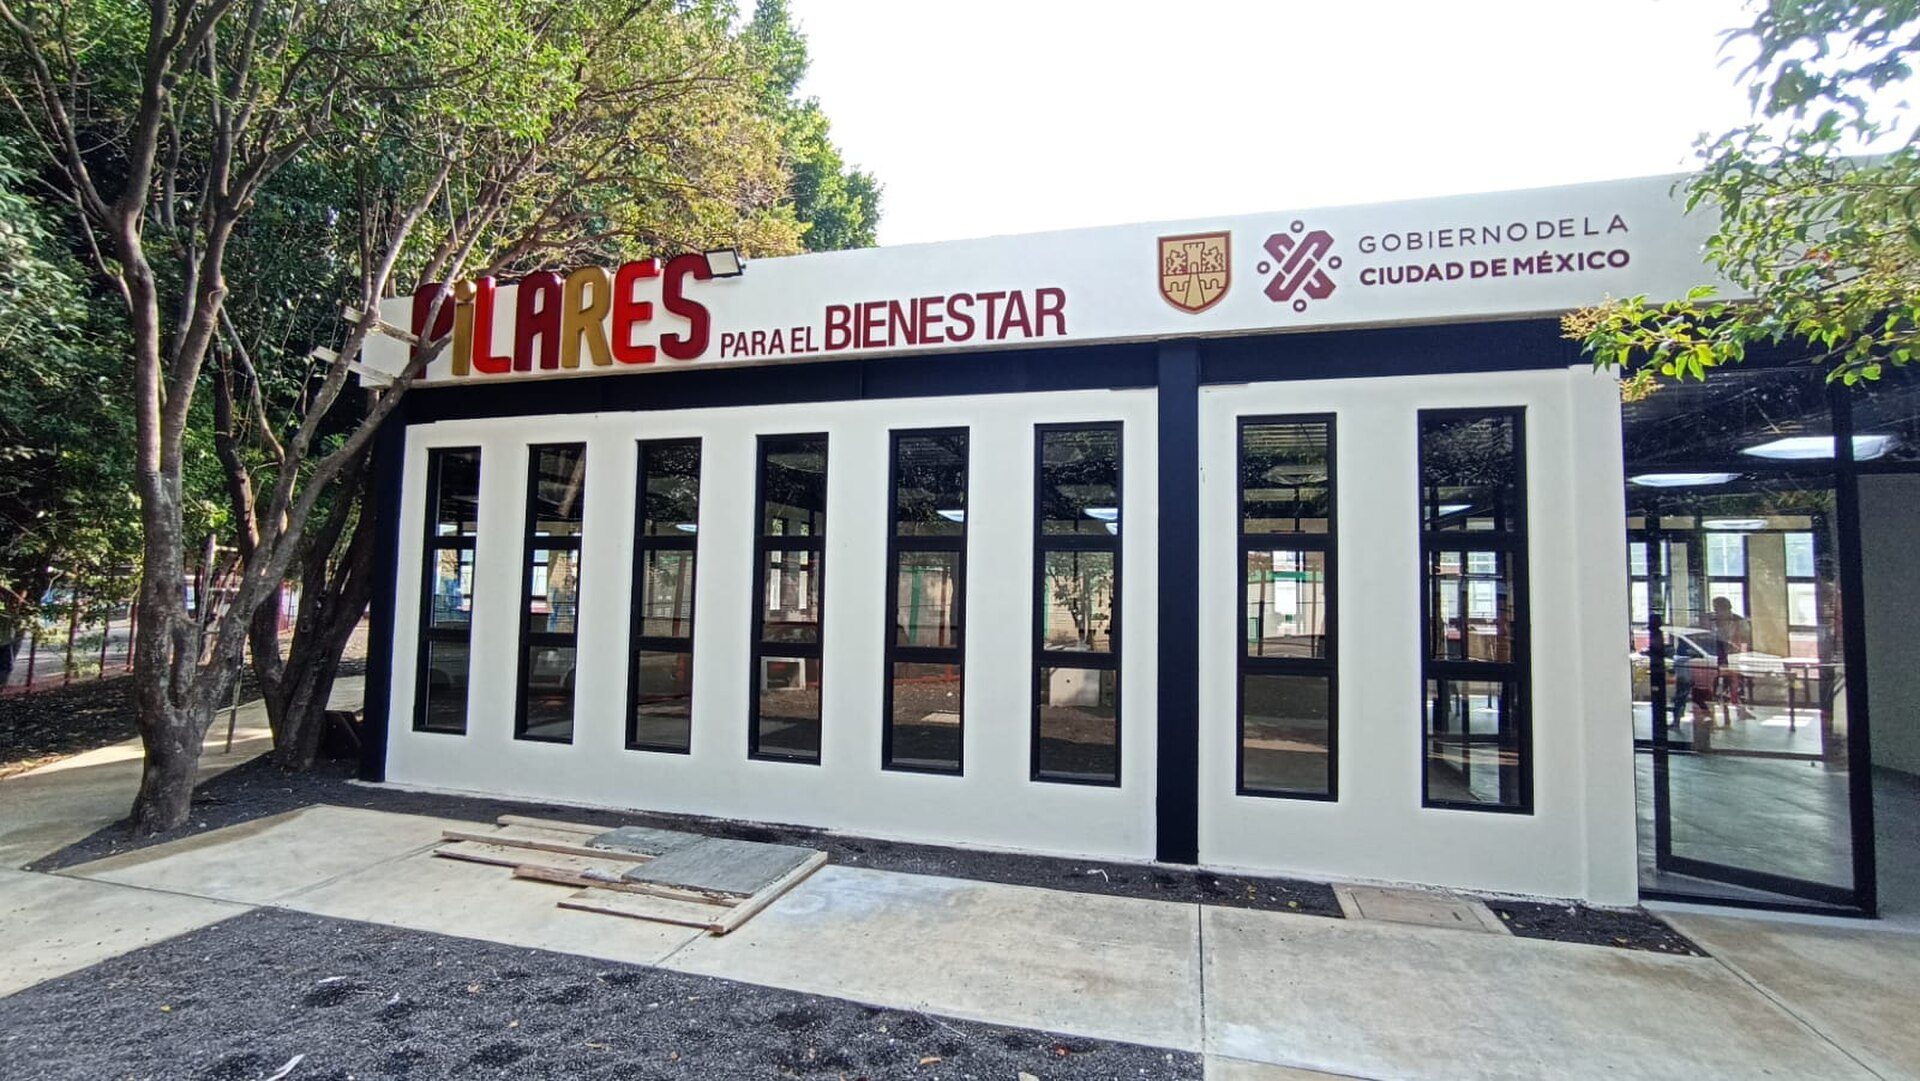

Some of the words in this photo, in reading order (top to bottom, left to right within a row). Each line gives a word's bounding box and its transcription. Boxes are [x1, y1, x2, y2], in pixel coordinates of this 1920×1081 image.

[1358, 222, 1528, 254] GOBIERNO
[1536, 218, 1575, 240] DE
[1584, 214, 1628, 236] LA
[1359, 261, 1464, 286] CIUDAD
[1470, 257, 1507, 278] DE
[1513, 249, 1630, 276] MÉXICO
[720, 328, 786, 358] PARA
[790, 326, 819, 353] EL
[824, 287, 1067, 351] BIENESTAR
